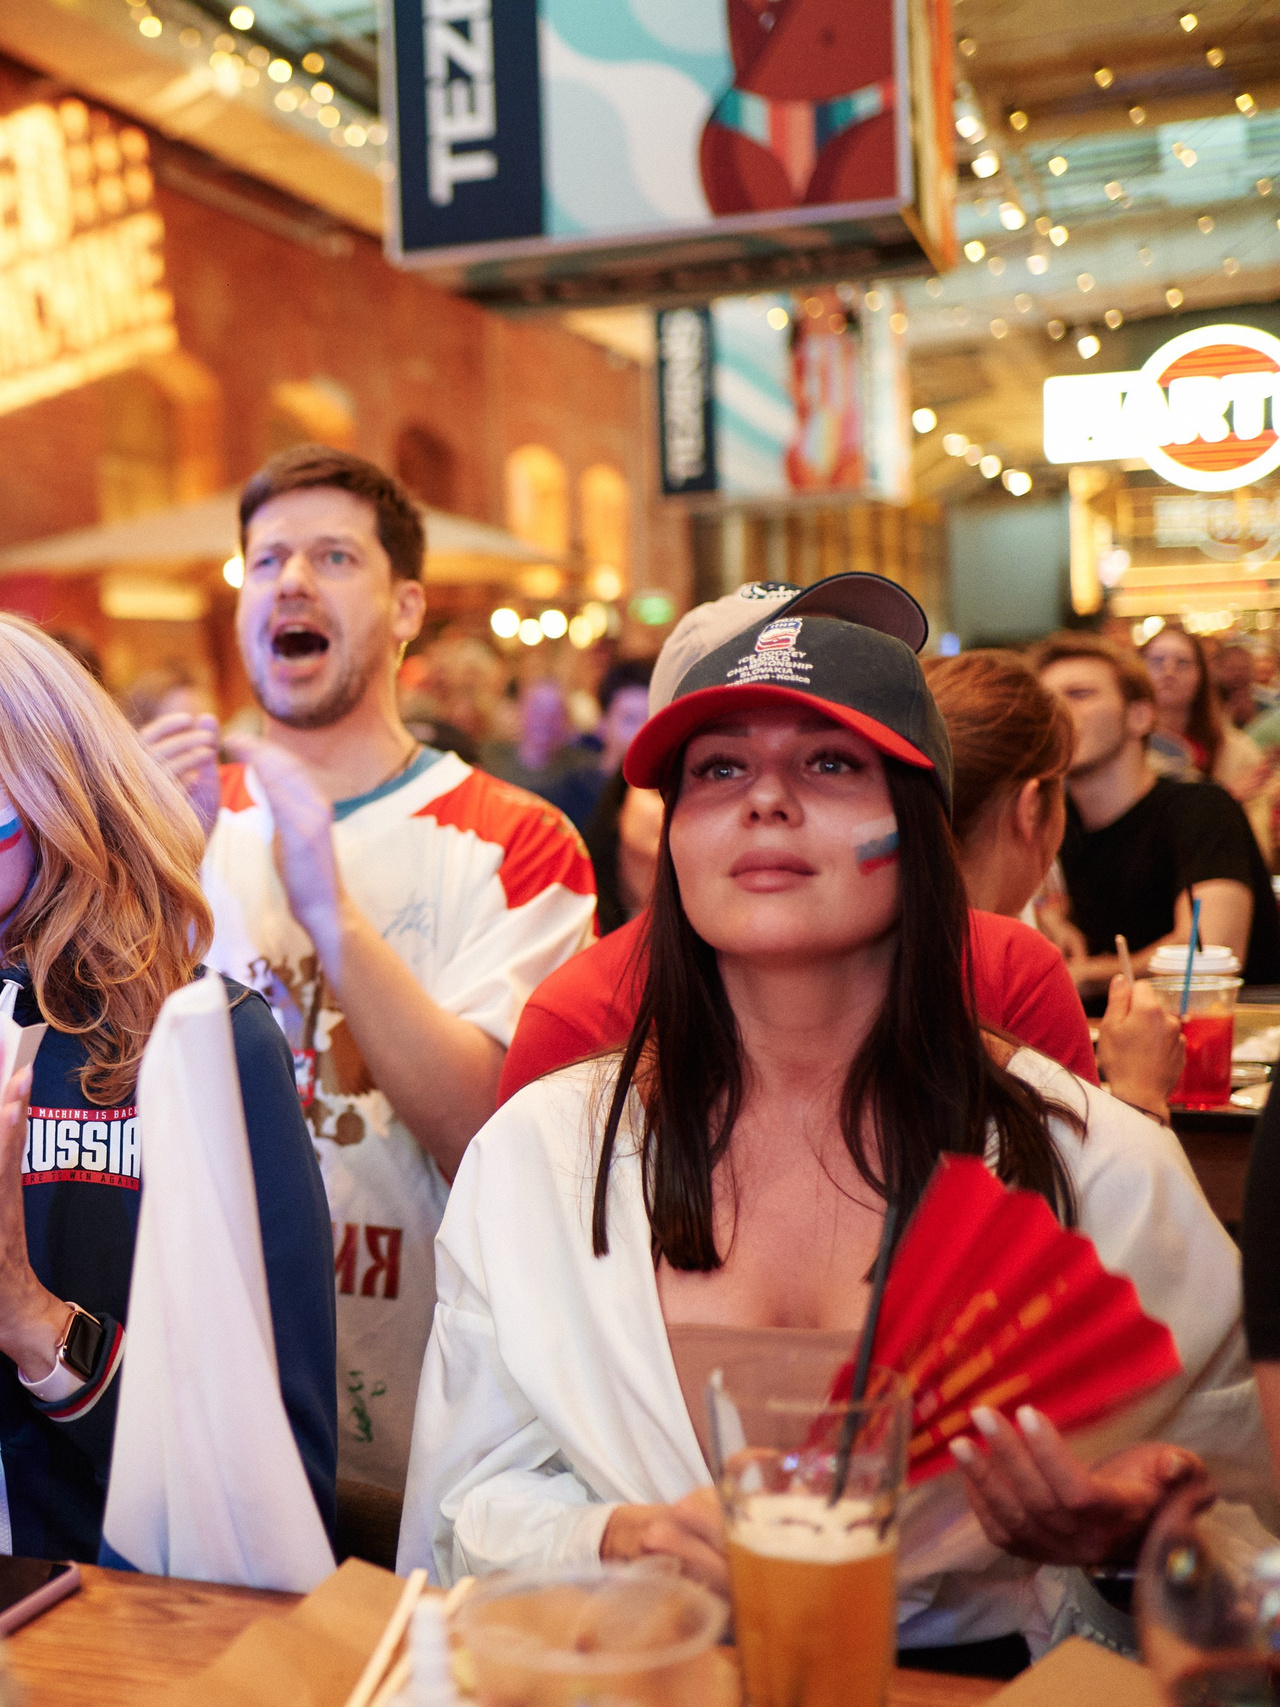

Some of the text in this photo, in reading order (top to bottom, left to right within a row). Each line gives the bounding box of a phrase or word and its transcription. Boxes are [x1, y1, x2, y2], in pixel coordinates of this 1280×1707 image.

[738, 649, 807, 665] ICE HOCKEY
[726, 660, 814, 677] CHAMPIONSHIP
[740, 667, 794, 678] SLOVAKIA
[39, 1109, 89, 1120] MACHINE
[95, 1111, 107, 1120] IS
[70, 1171, 92, 1181] WIN
[100, 1174, 136, 1188] AGAIN
